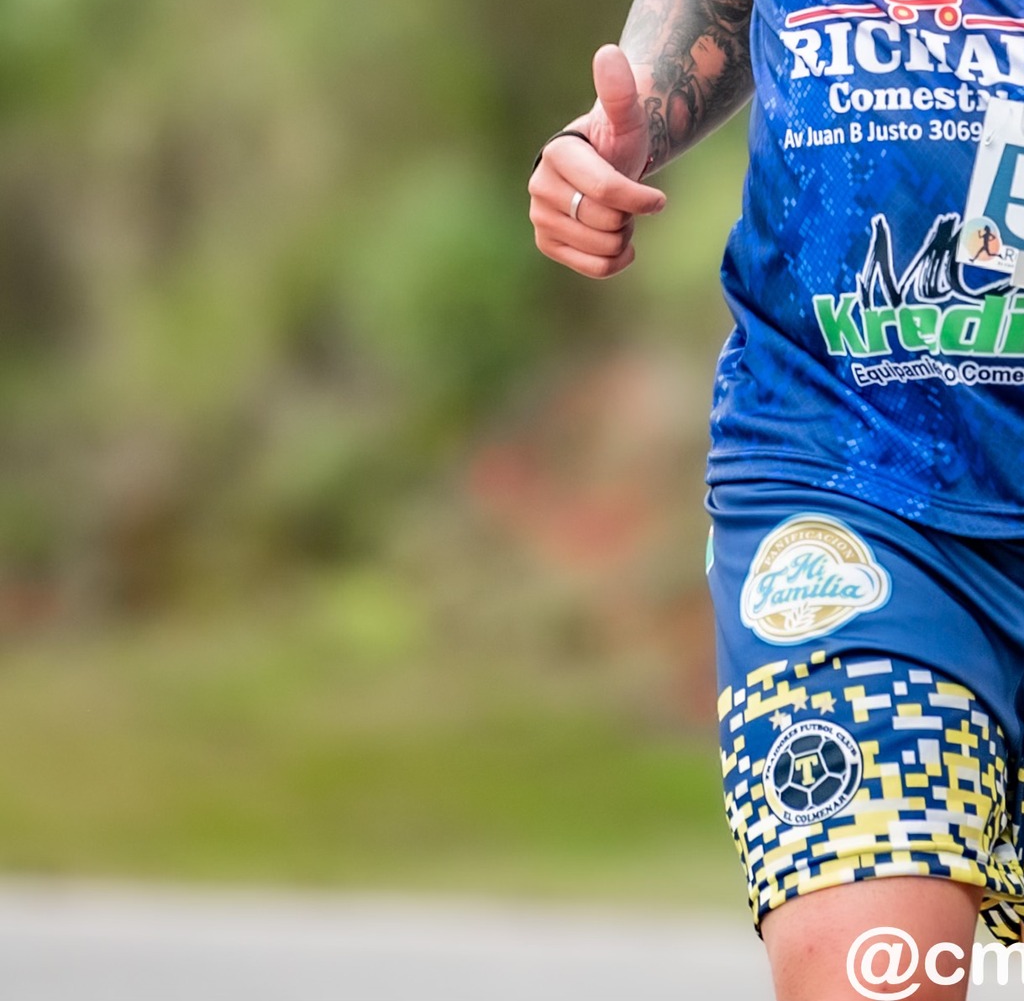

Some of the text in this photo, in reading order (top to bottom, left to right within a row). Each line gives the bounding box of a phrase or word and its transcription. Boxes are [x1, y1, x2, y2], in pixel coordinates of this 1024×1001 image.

[784, 120, 982, 149] Av Juan B Justo 3069
[787, 552, 828, 583] Mi
[752, 566, 866, 614] Familia
[800, 723, 834, 734] FUTBOL
[836, 732, 858, 757] CLUB
[795, 754, 820, 787] T
[783, 794, 847, 823] EL COLMENAR
